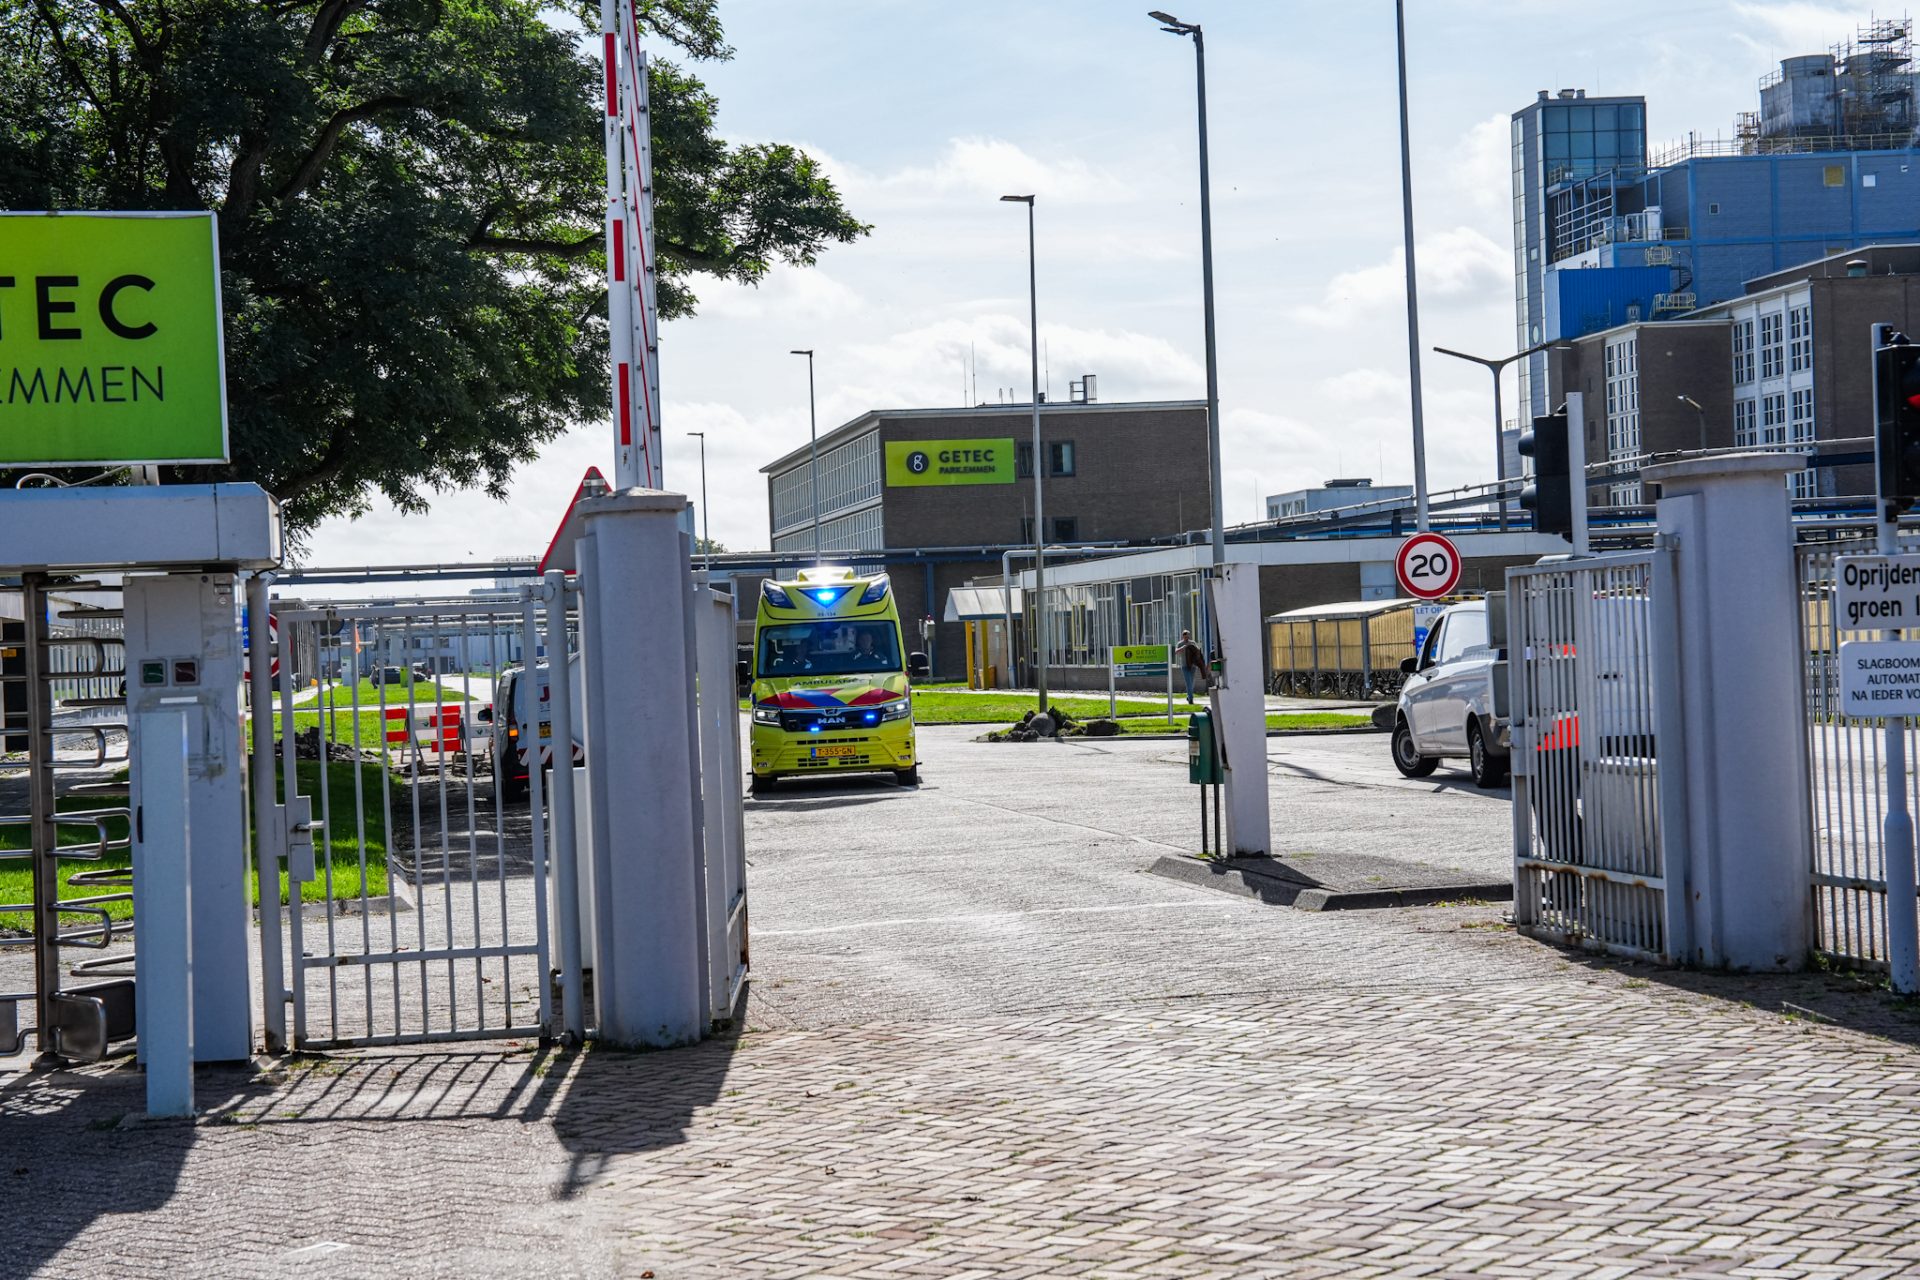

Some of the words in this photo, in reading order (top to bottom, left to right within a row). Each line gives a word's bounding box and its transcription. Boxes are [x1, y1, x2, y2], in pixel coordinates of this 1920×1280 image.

[0, 366, 164, 404] MMEN
[939, 449, 994, 463] GETEC
[1410, 553, 1447, 578] 20
[1844, 563, 1920, 593] Oprijden
[1416, 607, 1429, 615] LET
[1848, 599, 1902, 625] groen
[1858, 657, 1920, 670] SLAGBOOM
[1867, 673, 1920, 685] AUTOMAT
[1852, 690, 1868, 701] NA
[1871, 689, 1903, 700] IEDER
